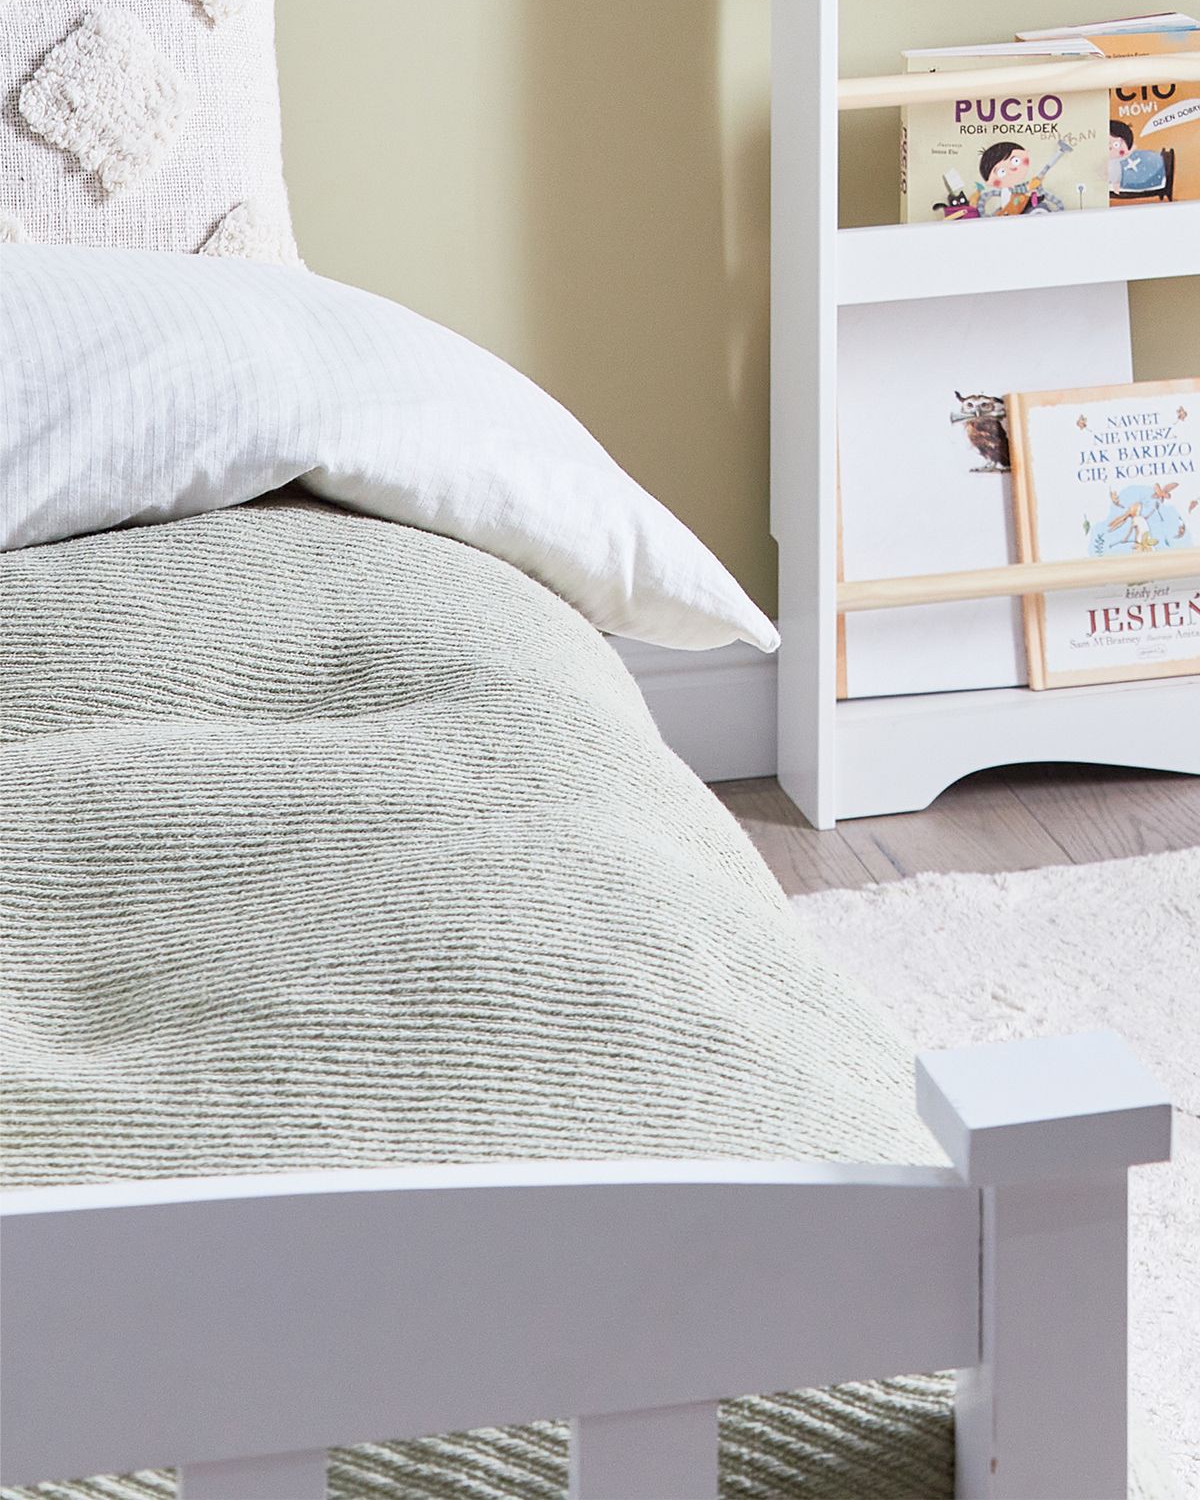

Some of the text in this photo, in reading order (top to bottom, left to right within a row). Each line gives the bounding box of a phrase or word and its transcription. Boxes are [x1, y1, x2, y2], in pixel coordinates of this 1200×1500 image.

[1109, 83, 1176, 102] CIO
[1177, 104, 1200, 118] DOBRY
[992, 123, 1059, 136] PORZĄDEK
[1107, 412, 1160, 428] NAWET
[1093, 432, 1121, 446] NIE
[1080, 442, 1192, 465] JAK BARDZO
[1115, 460, 1195, 479] KOCHAM
[1150, 586, 1170, 601] jest
[1069, 640, 1090, 650] Sam
[1175, 628, 1200, 640] Anita
